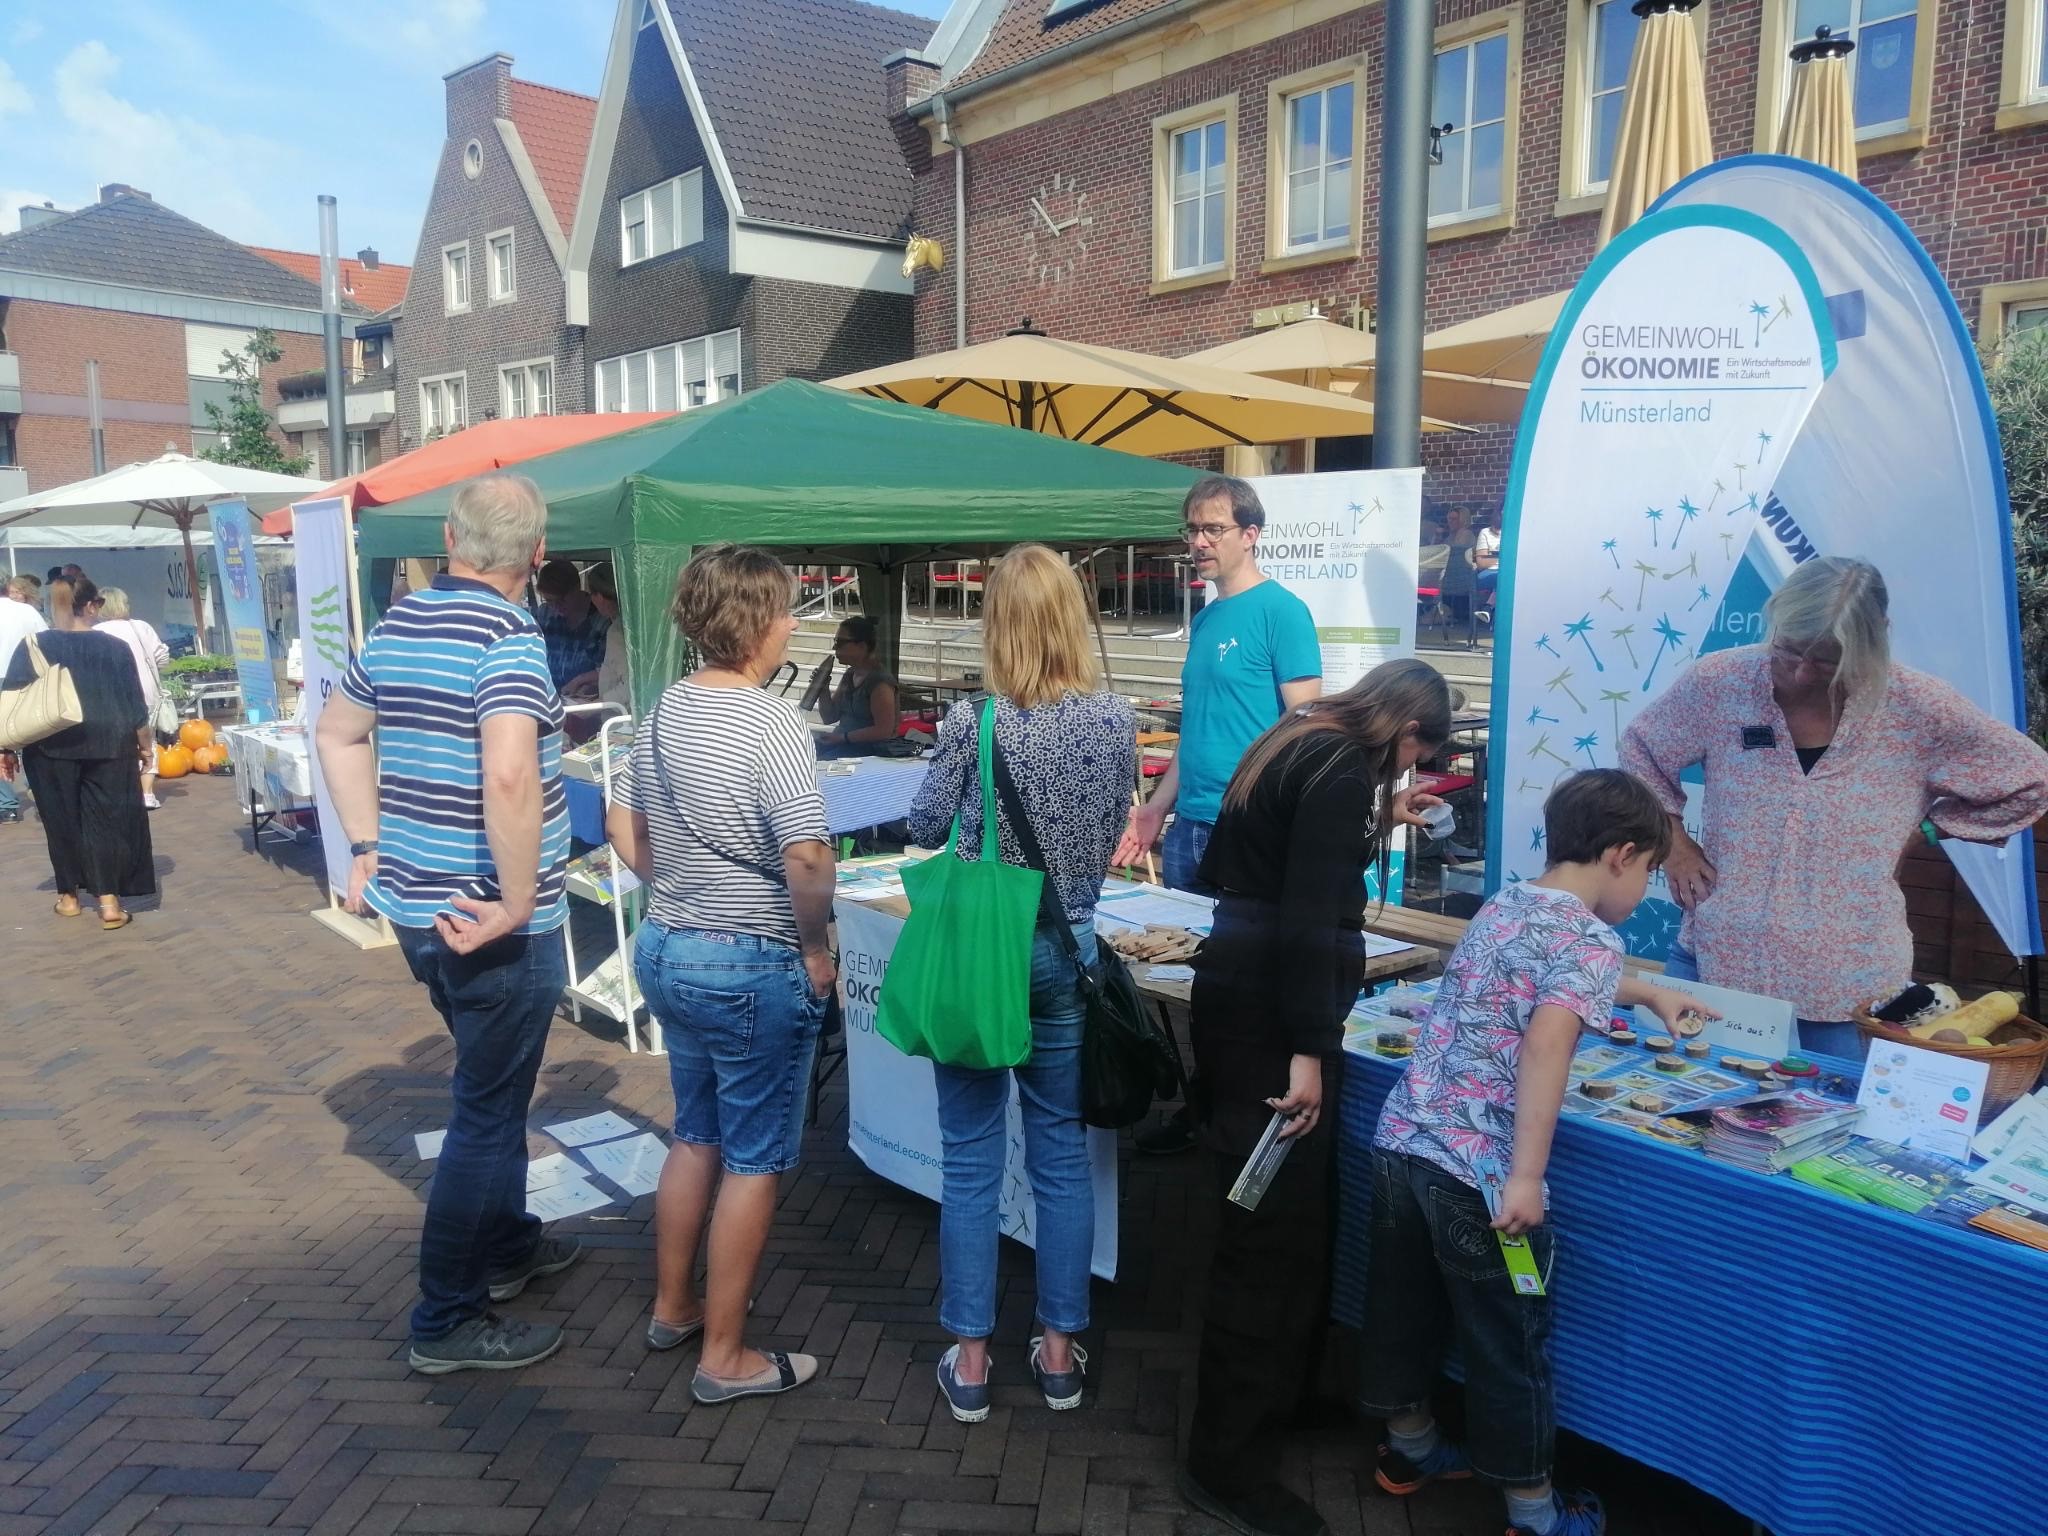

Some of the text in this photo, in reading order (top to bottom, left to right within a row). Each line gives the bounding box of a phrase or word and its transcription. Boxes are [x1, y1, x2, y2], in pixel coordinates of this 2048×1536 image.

[1582, 324, 1745, 349] GEMEINWOHL
[1581, 351, 1720, 379] ÖKONOMIE
[1726, 357, 1811, 367] Ein Wirtschaftsmodell
[1725, 369, 1771, 379] mit Zukunft
[1580, 399, 1712, 424] Münsterland
[1257, 563, 1358, 580] STERLAND
